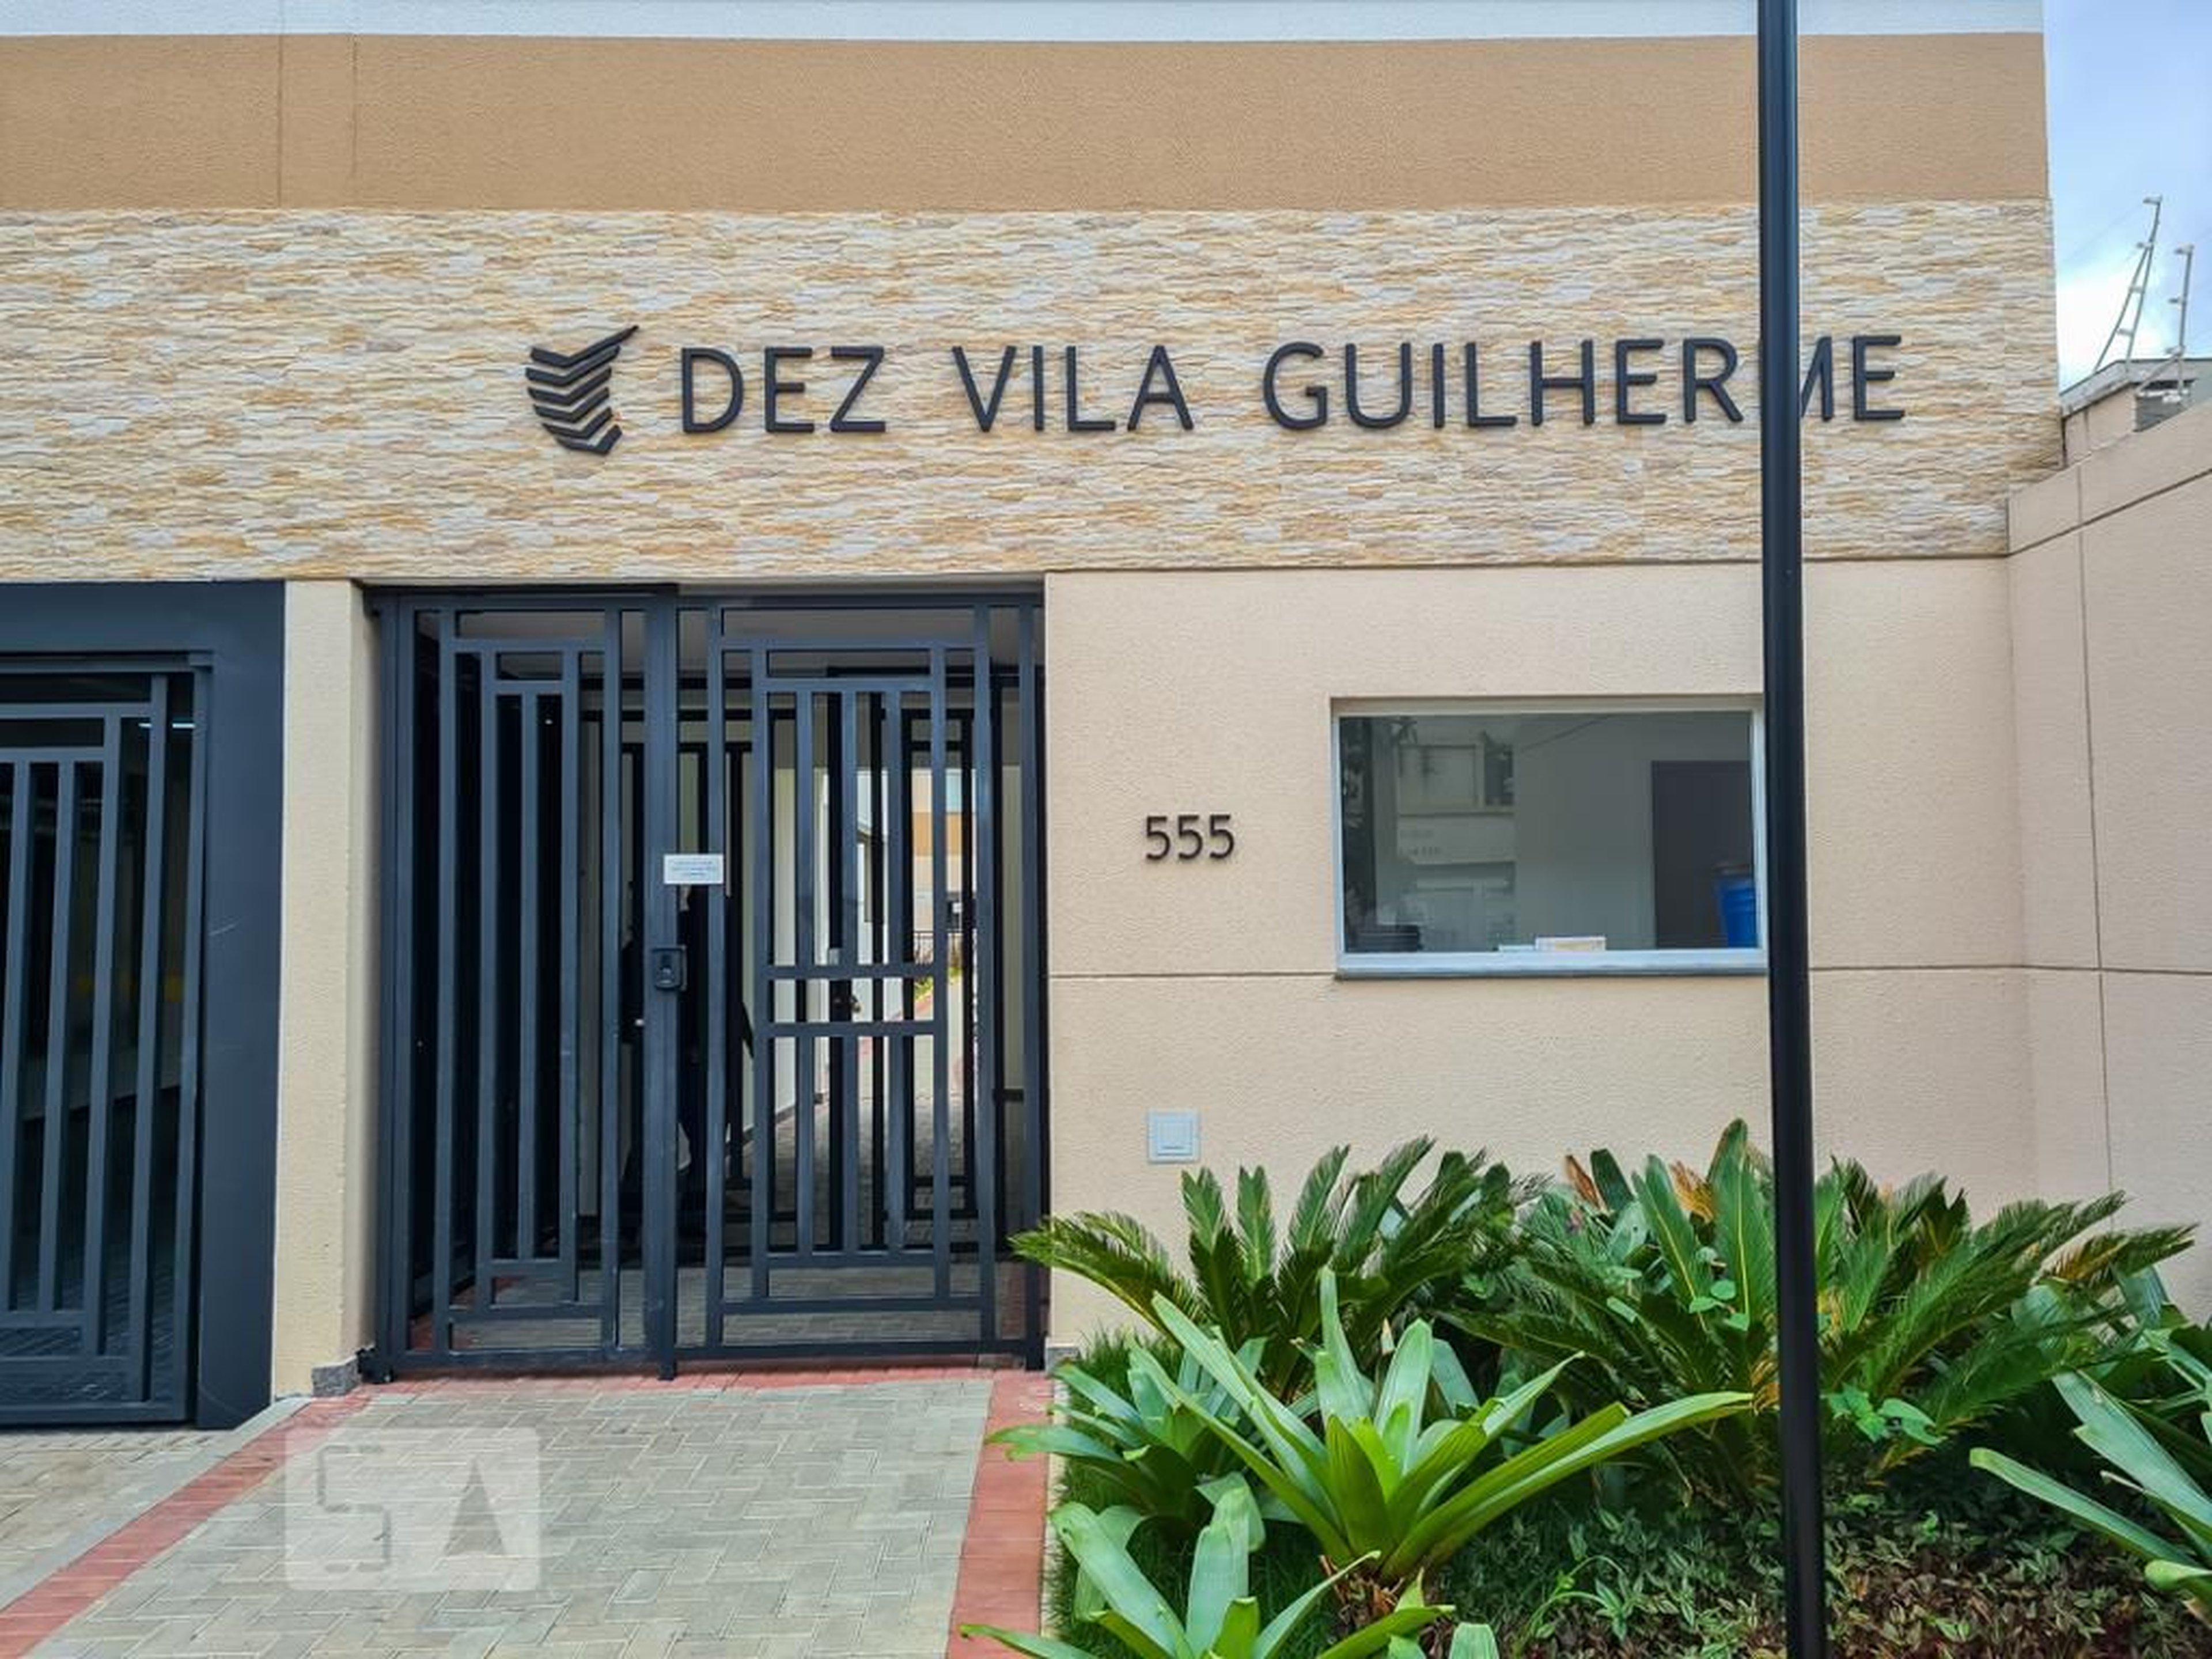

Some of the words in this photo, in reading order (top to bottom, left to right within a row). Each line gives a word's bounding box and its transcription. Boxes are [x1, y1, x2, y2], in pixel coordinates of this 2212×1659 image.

[680, 346, 887, 436] DEZ
[950, 344, 1194, 434] VILA
[1146, 815, 1234, 861] 555
